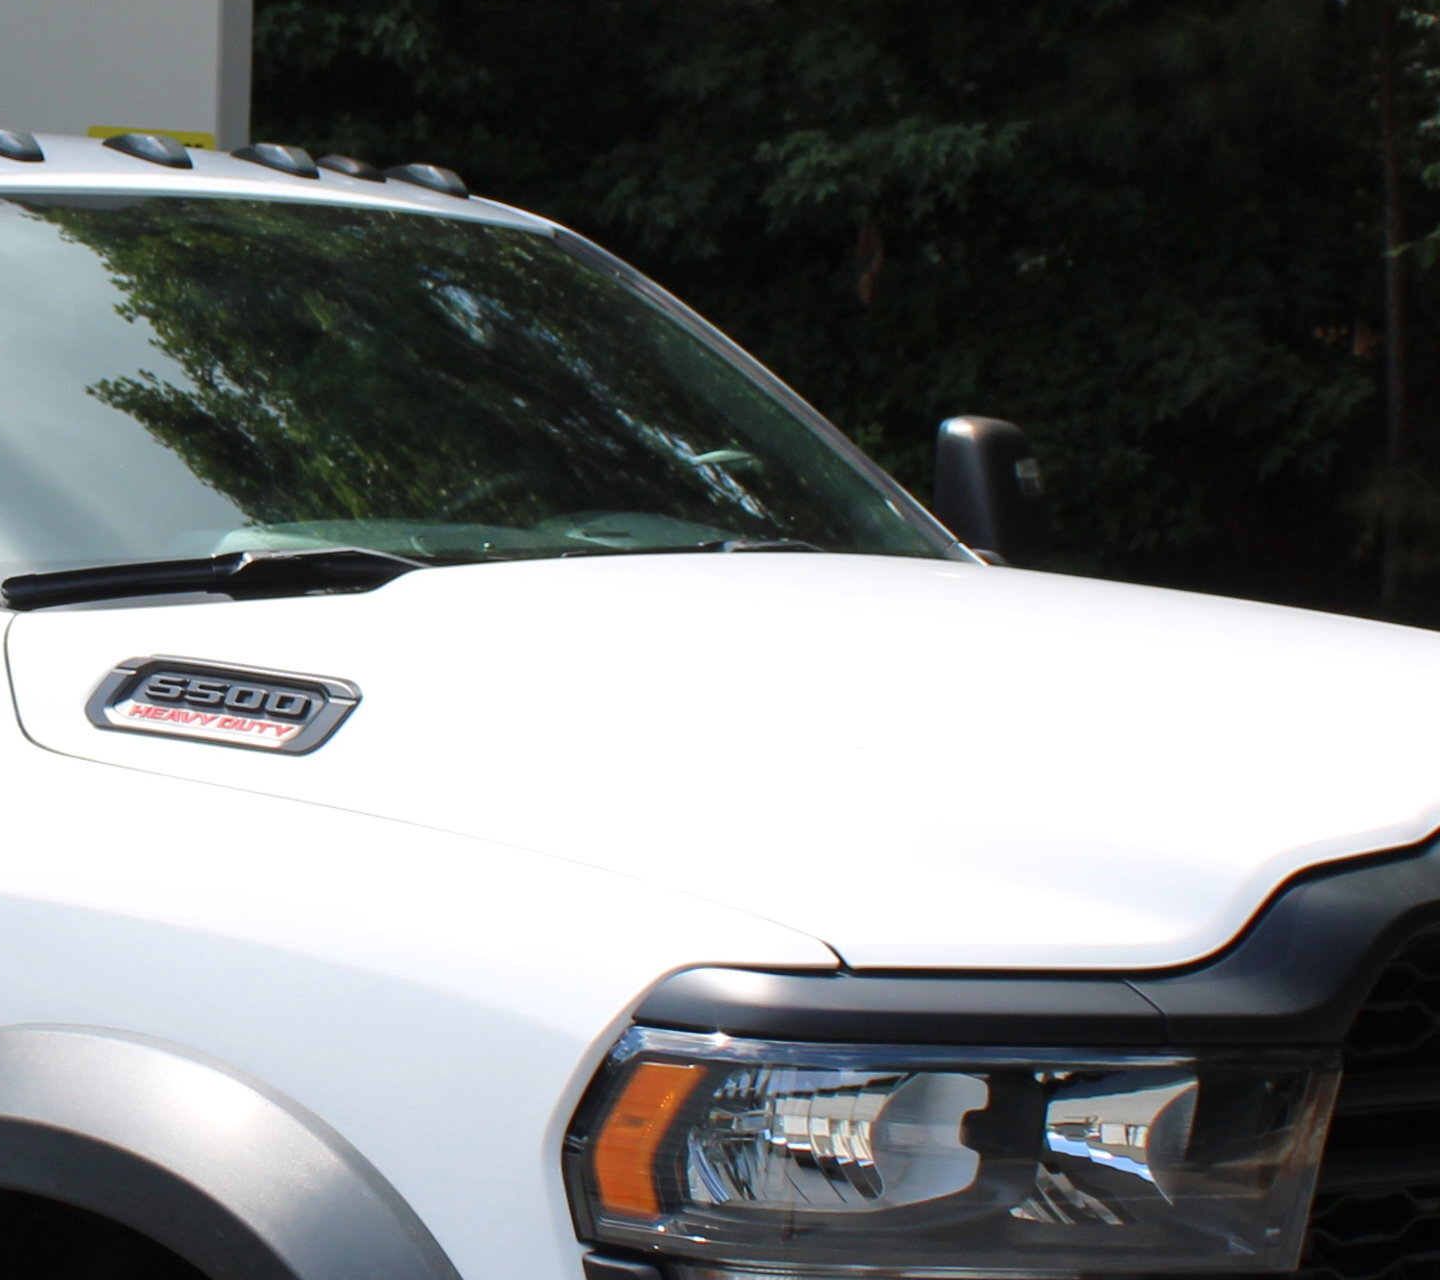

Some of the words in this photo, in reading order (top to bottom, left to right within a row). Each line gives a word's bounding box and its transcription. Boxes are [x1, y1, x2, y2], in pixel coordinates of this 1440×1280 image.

[144, 675, 312, 719] 5500
[128, 704, 219, 728] HEAVY
[216, 717, 296, 737] DUTY
